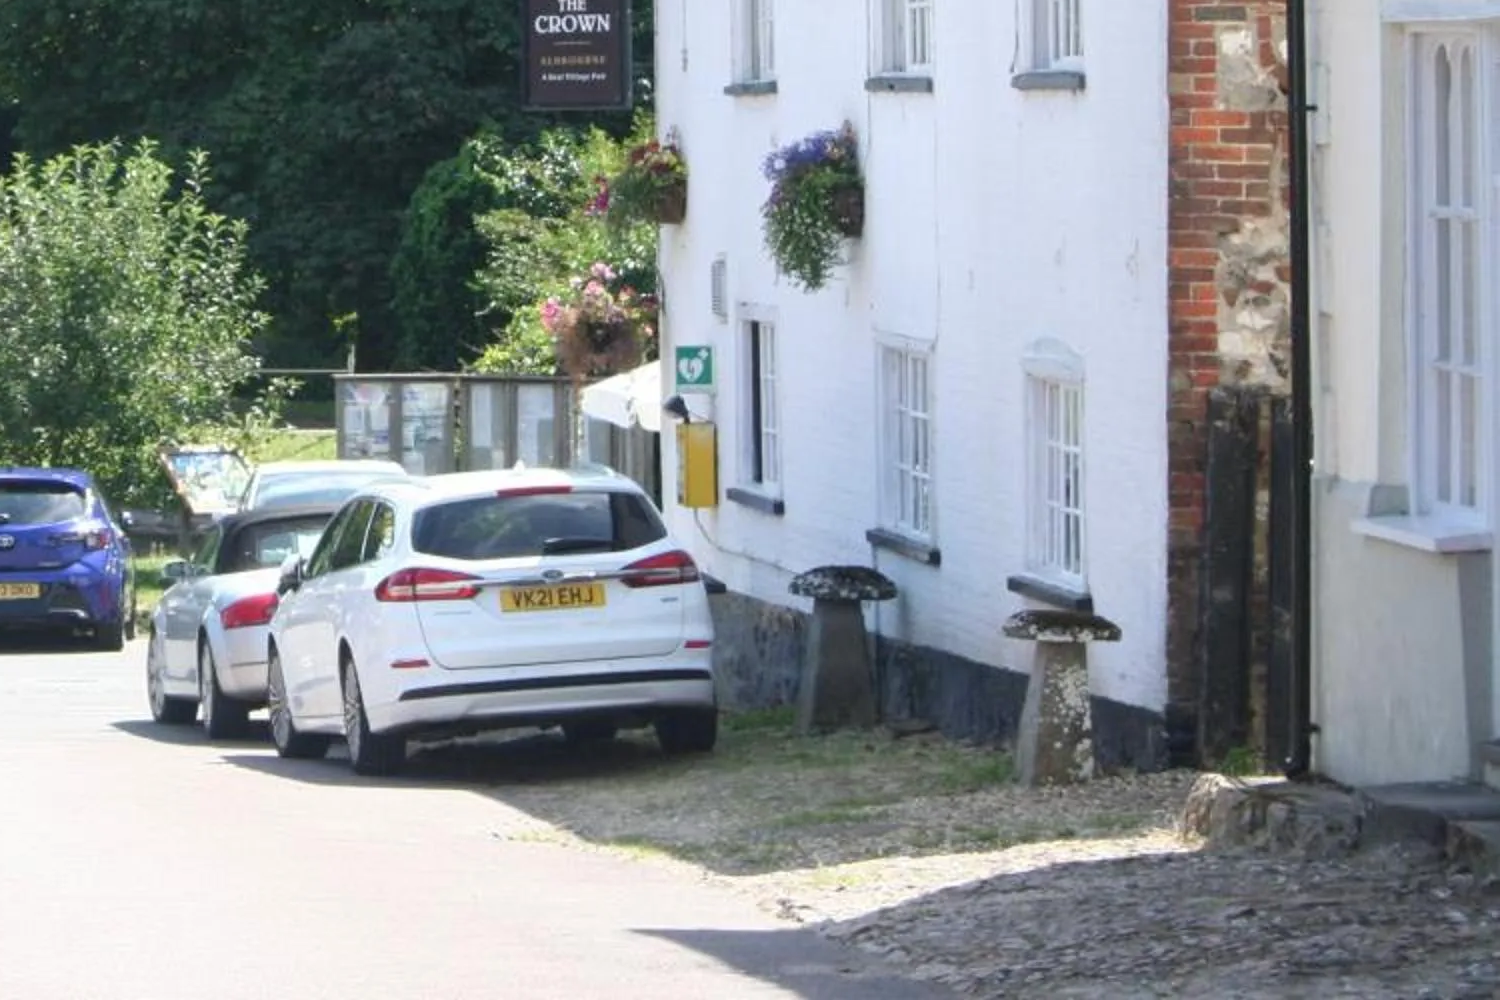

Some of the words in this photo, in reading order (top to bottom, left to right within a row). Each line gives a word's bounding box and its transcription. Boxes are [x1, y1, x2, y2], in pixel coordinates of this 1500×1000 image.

[534, 14, 611, 33] CROWN
[512, 587, 553, 608] VK21
[558, 584, 593, 604] EHJ
